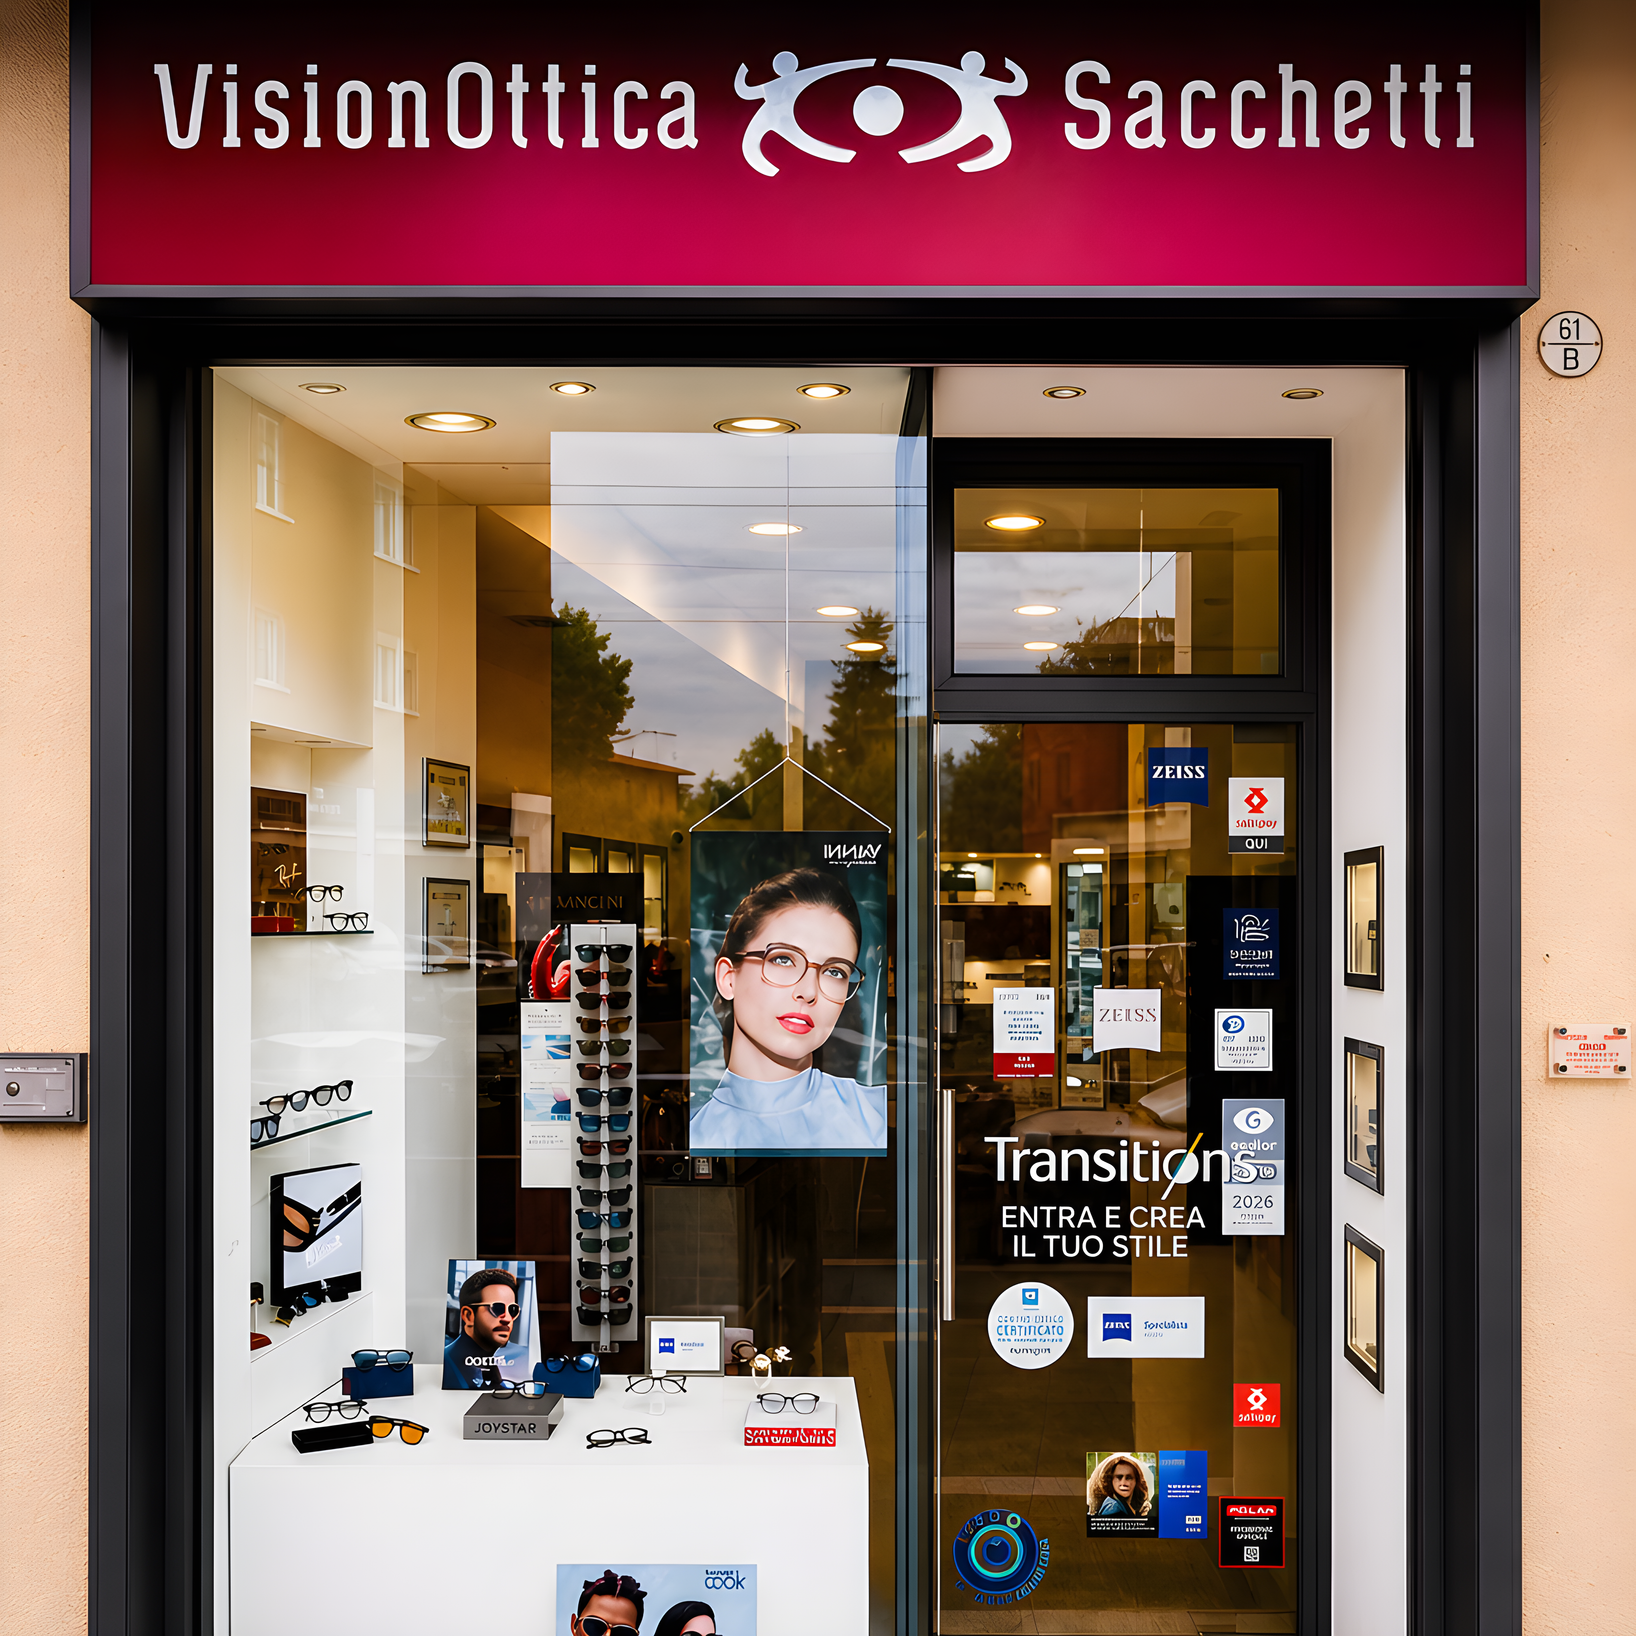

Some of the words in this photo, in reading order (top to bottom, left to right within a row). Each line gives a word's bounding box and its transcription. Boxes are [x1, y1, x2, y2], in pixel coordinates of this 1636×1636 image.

[153, 61, 699, 149] VisionOttica
[1064, 60, 1475, 150] Sacchetti
[1559, 317, 1580, 340] 61
[1563, 347, 1579, 370] B
[1152, 765, 1205, 779] ZEISS
[1099, 1008, 1158, 1023] ZEISS
[984, 1132, 1258, 1200] Transitions
[1232, 1195, 1274, 1209] 2026
[1002, 1206, 1097, 1229] ENTRA
[1105, 1206, 1121, 1229] E
[1129, 1206, 1206, 1229] CREA
[1013, 1235, 1036, 1258] IL
[1043, 1235, 1104, 1258] TUO
[1112, 1235, 1189, 1258] STILE
[474, 1422, 537, 1434] JOYSTAR
